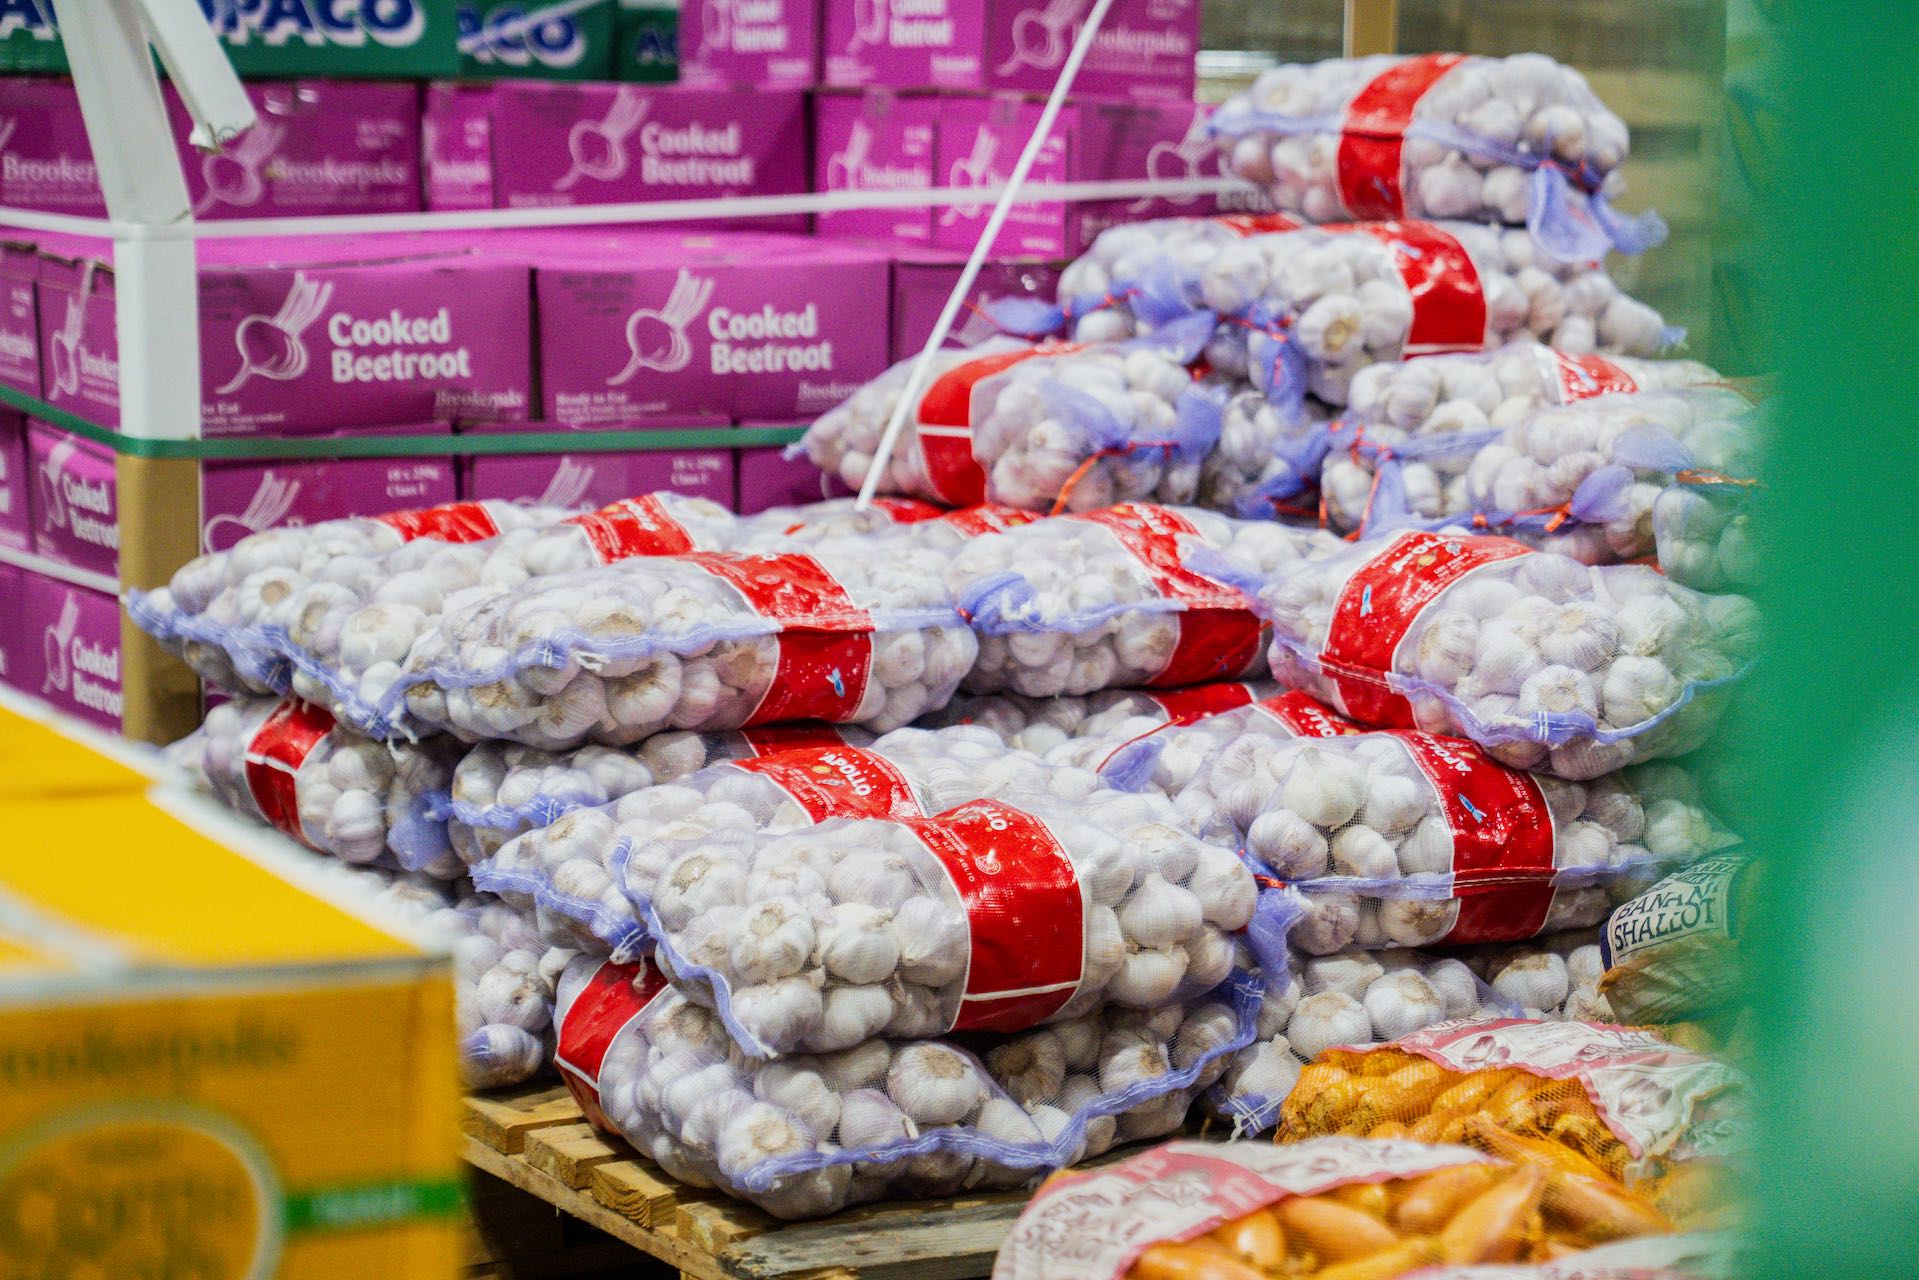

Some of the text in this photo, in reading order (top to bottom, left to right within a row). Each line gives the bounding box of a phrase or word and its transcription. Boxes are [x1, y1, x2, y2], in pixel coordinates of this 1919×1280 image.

[328, 307, 452, 347] Cooked
[708, 302, 818, 341] Cooked
[331, 347, 472, 383] Beetroot
[710, 339, 833, 375] Beetroot
[1416, 731, 1473, 772] APOLLO
[818, 752, 872, 796] APOLLO
[1614, 897, 1717, 952] SHALLOT
